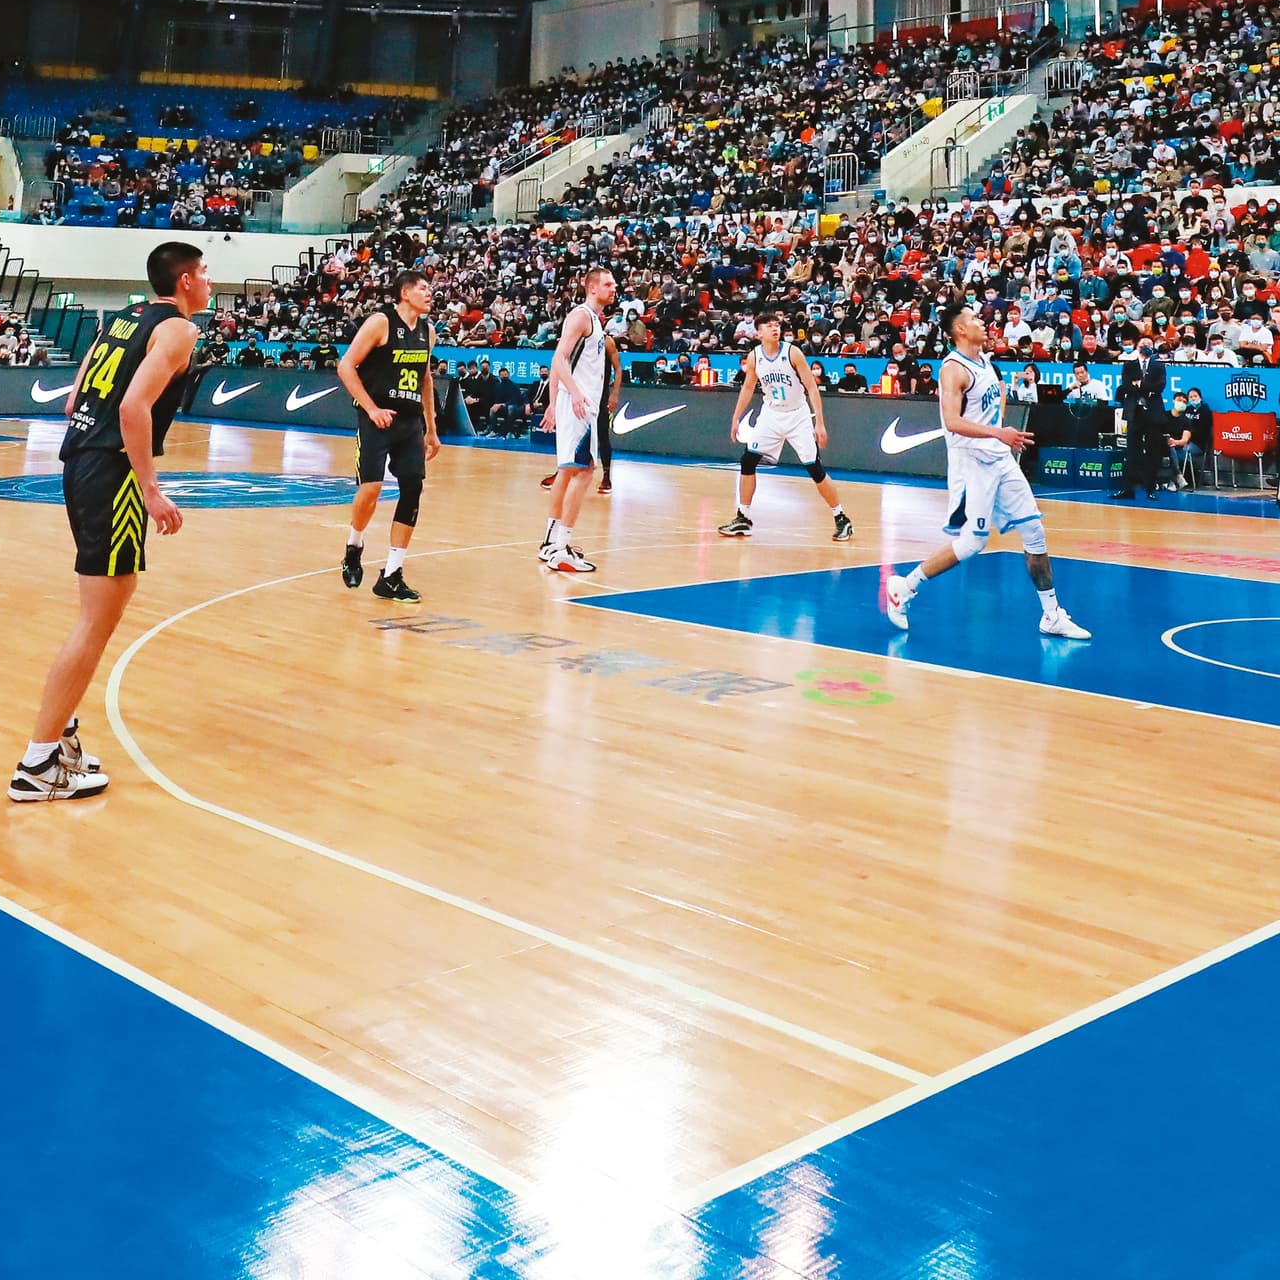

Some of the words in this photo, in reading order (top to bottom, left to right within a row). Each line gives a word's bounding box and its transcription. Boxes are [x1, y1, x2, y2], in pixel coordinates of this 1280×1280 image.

[81, 342, 126, 400] 24
[398, 368, 419, 392] 26
[772, 386, 786, 400] 21
[1225, 382, 1267, 399] BRAVES
[1222, 431, 1253, 441] SPALDING
[1044, 460, 1067, 468] AEB
